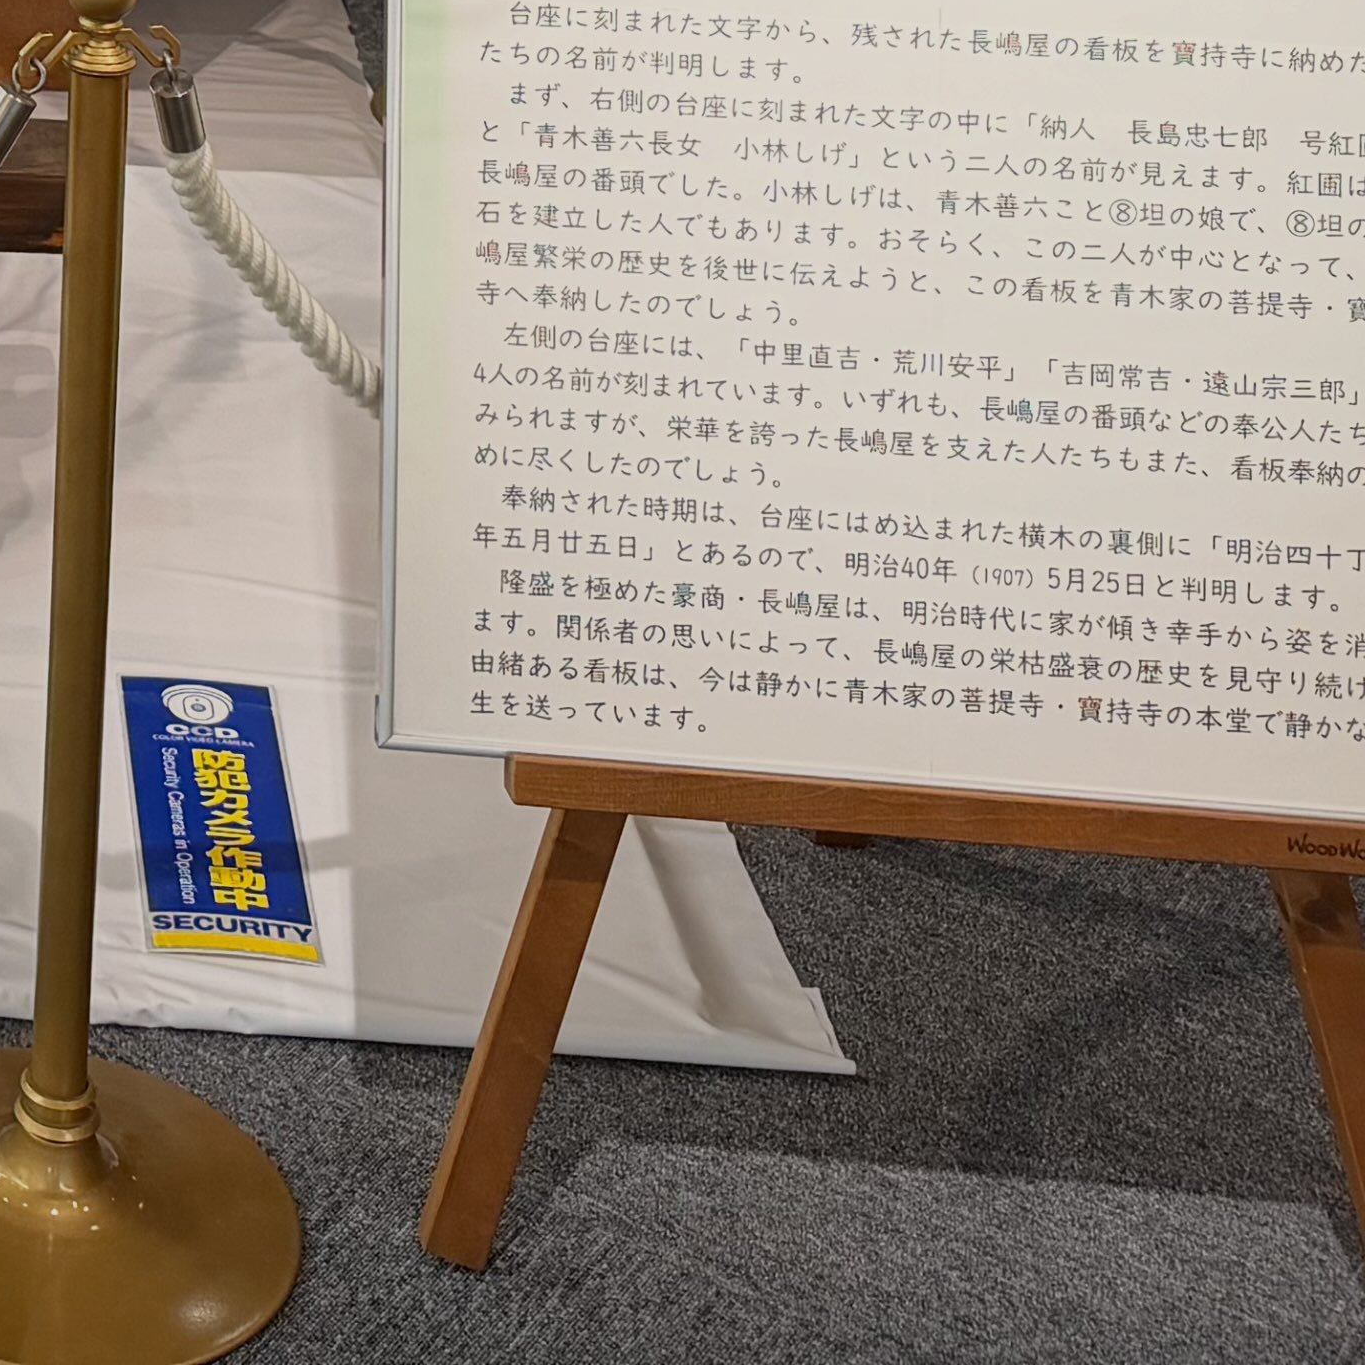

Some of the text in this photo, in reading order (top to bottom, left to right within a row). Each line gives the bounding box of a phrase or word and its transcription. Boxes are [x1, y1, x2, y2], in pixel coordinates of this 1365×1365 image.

[480, 41, 804, 85] たちの名前が判明します。
[1299, 129, 1365, 159] 号紅
[475, 279, 799, 327] 寺へ奉納したのでしょう。
[474, 442, 782, 488] めに尽くしたのでしょう。
[165, 723, 239, 739] CCD
[470, 690, 708, 733] 生を送っています。
[161, 747, 179, 789] Security
[167, 790, 186, 837] Cameras
[191, 748, 270, 912] 防犯カメラ作動中
[176, 852, 195, 905] Operation
[153, 914, 312, 943] SECURITY
